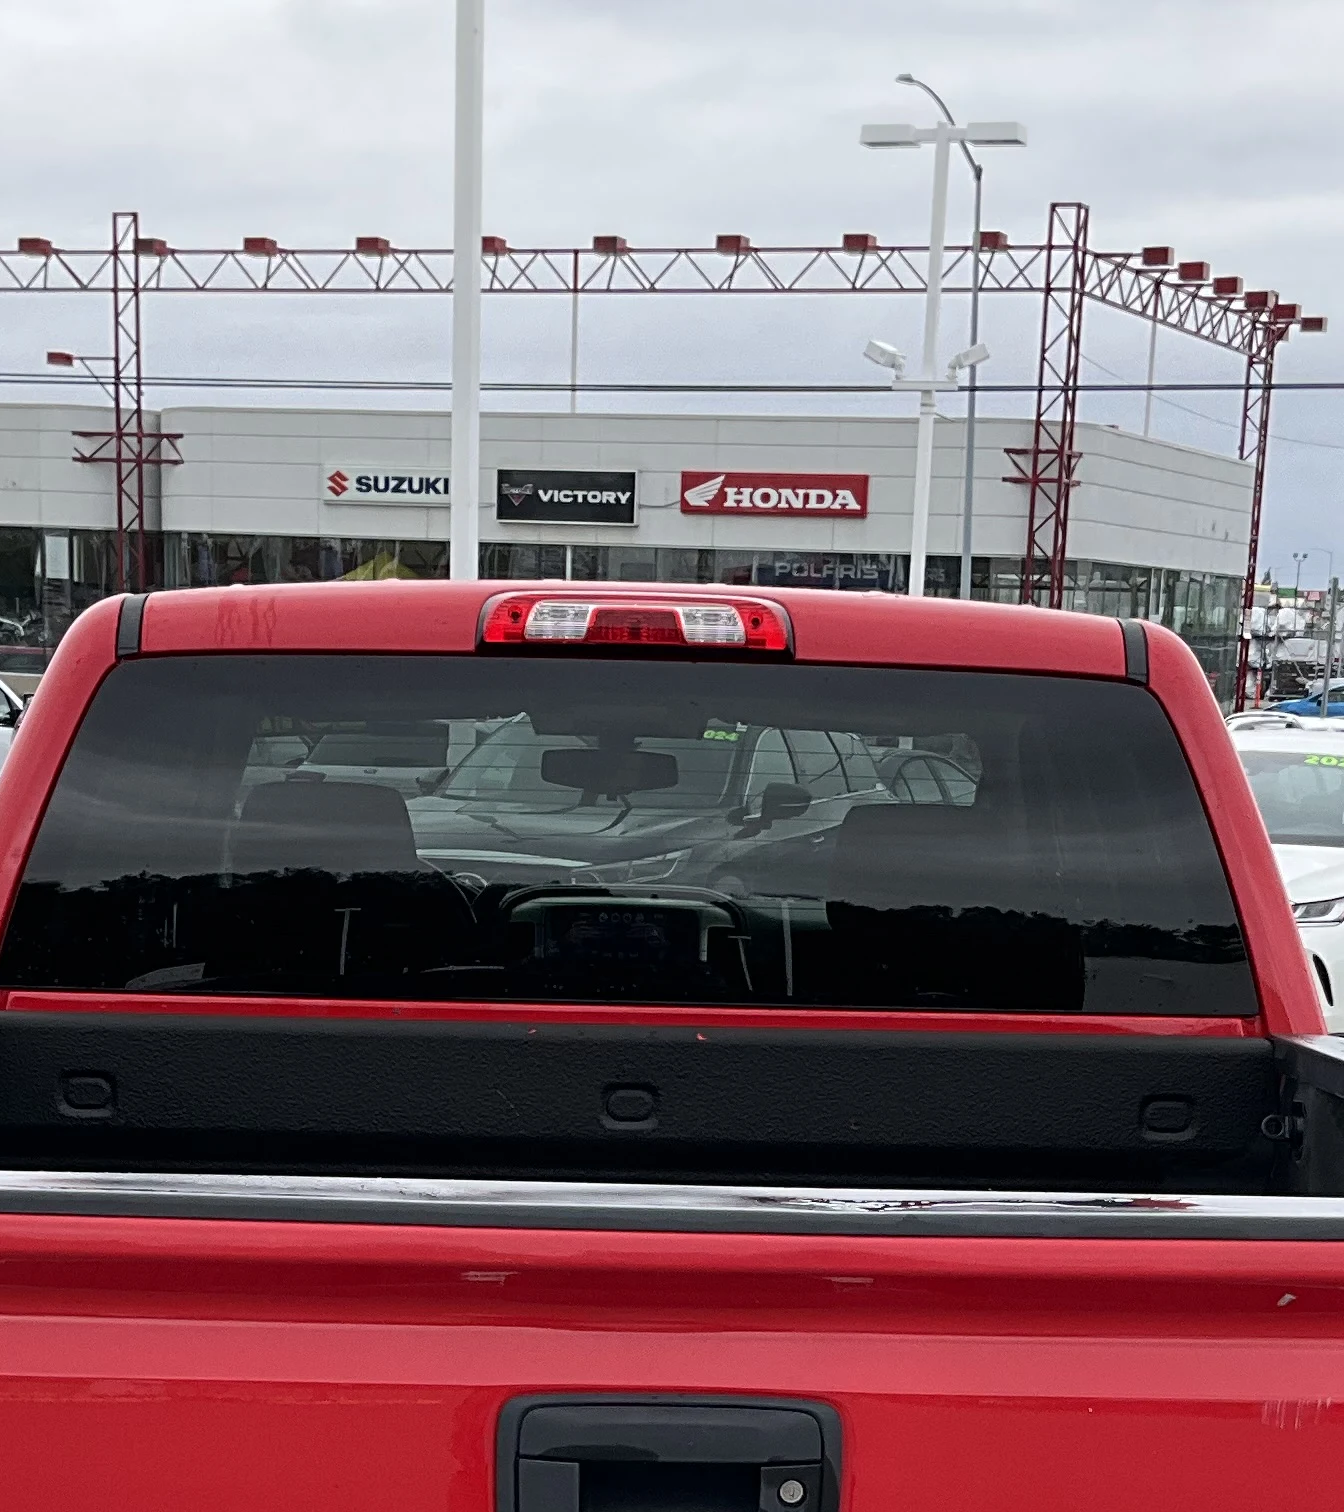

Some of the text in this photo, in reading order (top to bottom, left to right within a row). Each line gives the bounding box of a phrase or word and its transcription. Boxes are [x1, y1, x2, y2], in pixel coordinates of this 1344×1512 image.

[355, 475, 449, 494] SUZUKI
[538, 489, 632, 504] VICTORY
[723, 487, 862, 510] HONDA
[774, 562, 879, 580] POLARIS
